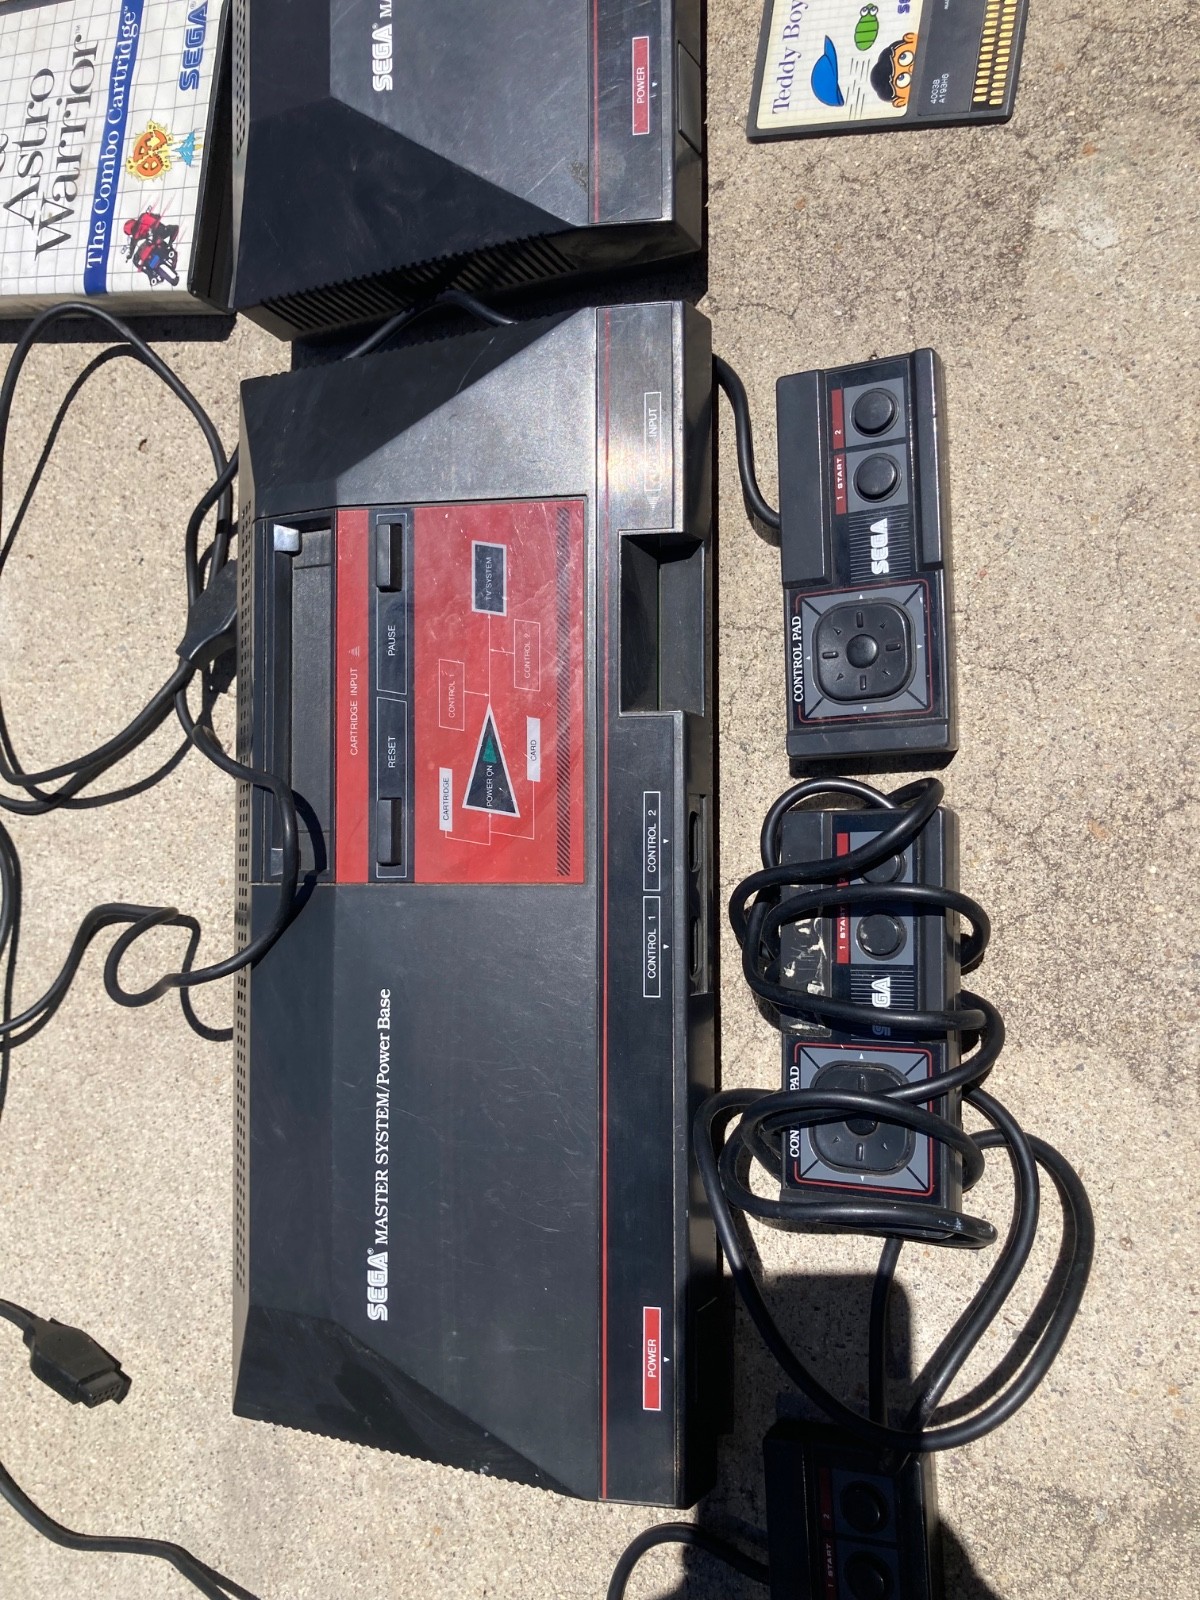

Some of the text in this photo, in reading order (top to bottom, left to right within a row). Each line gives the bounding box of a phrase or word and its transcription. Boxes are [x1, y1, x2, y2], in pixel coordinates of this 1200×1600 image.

[772, 0, 808, 115] Teddy Boy
[636, 66, 645, 104] POWER
[3, 68, 55, 230] Astro
[94, 130, 120, 212] Combo
[86, 220, 107, 269] The
[648, 407, 658, 437] INPUT
[870, 518, 890, 575] SEGA
[485, 557, 493, 589] SYSTEM
[387, 625, 396, 656] PAUSE
[523, 641, 531, 679] CONTROL
[791, 615, 803, 703] CONTROL PAD
[350, 667, 358, 755] CARTRIDGE INPUT
[448, 681, 456, 718] CONTROL
[387, 735, 396, 768] RESET
[486, 765, 493, 777] ON
[529, 739, 537, 761] CARD
[442, 777, 450, 821] CARTRIDGE
[647, 823, 657, 873] CONTROL
[647, 928, 657, 979] CONTROL
[377, 988, 391, 1031] Base
[375, 1032, 391, 1165] SYSTEM/Power
[790, 1066, 800, 1091] PAD
[375, 1168, 389, 1245] MASTER
[647, 1339, 657, 1378] POWER
